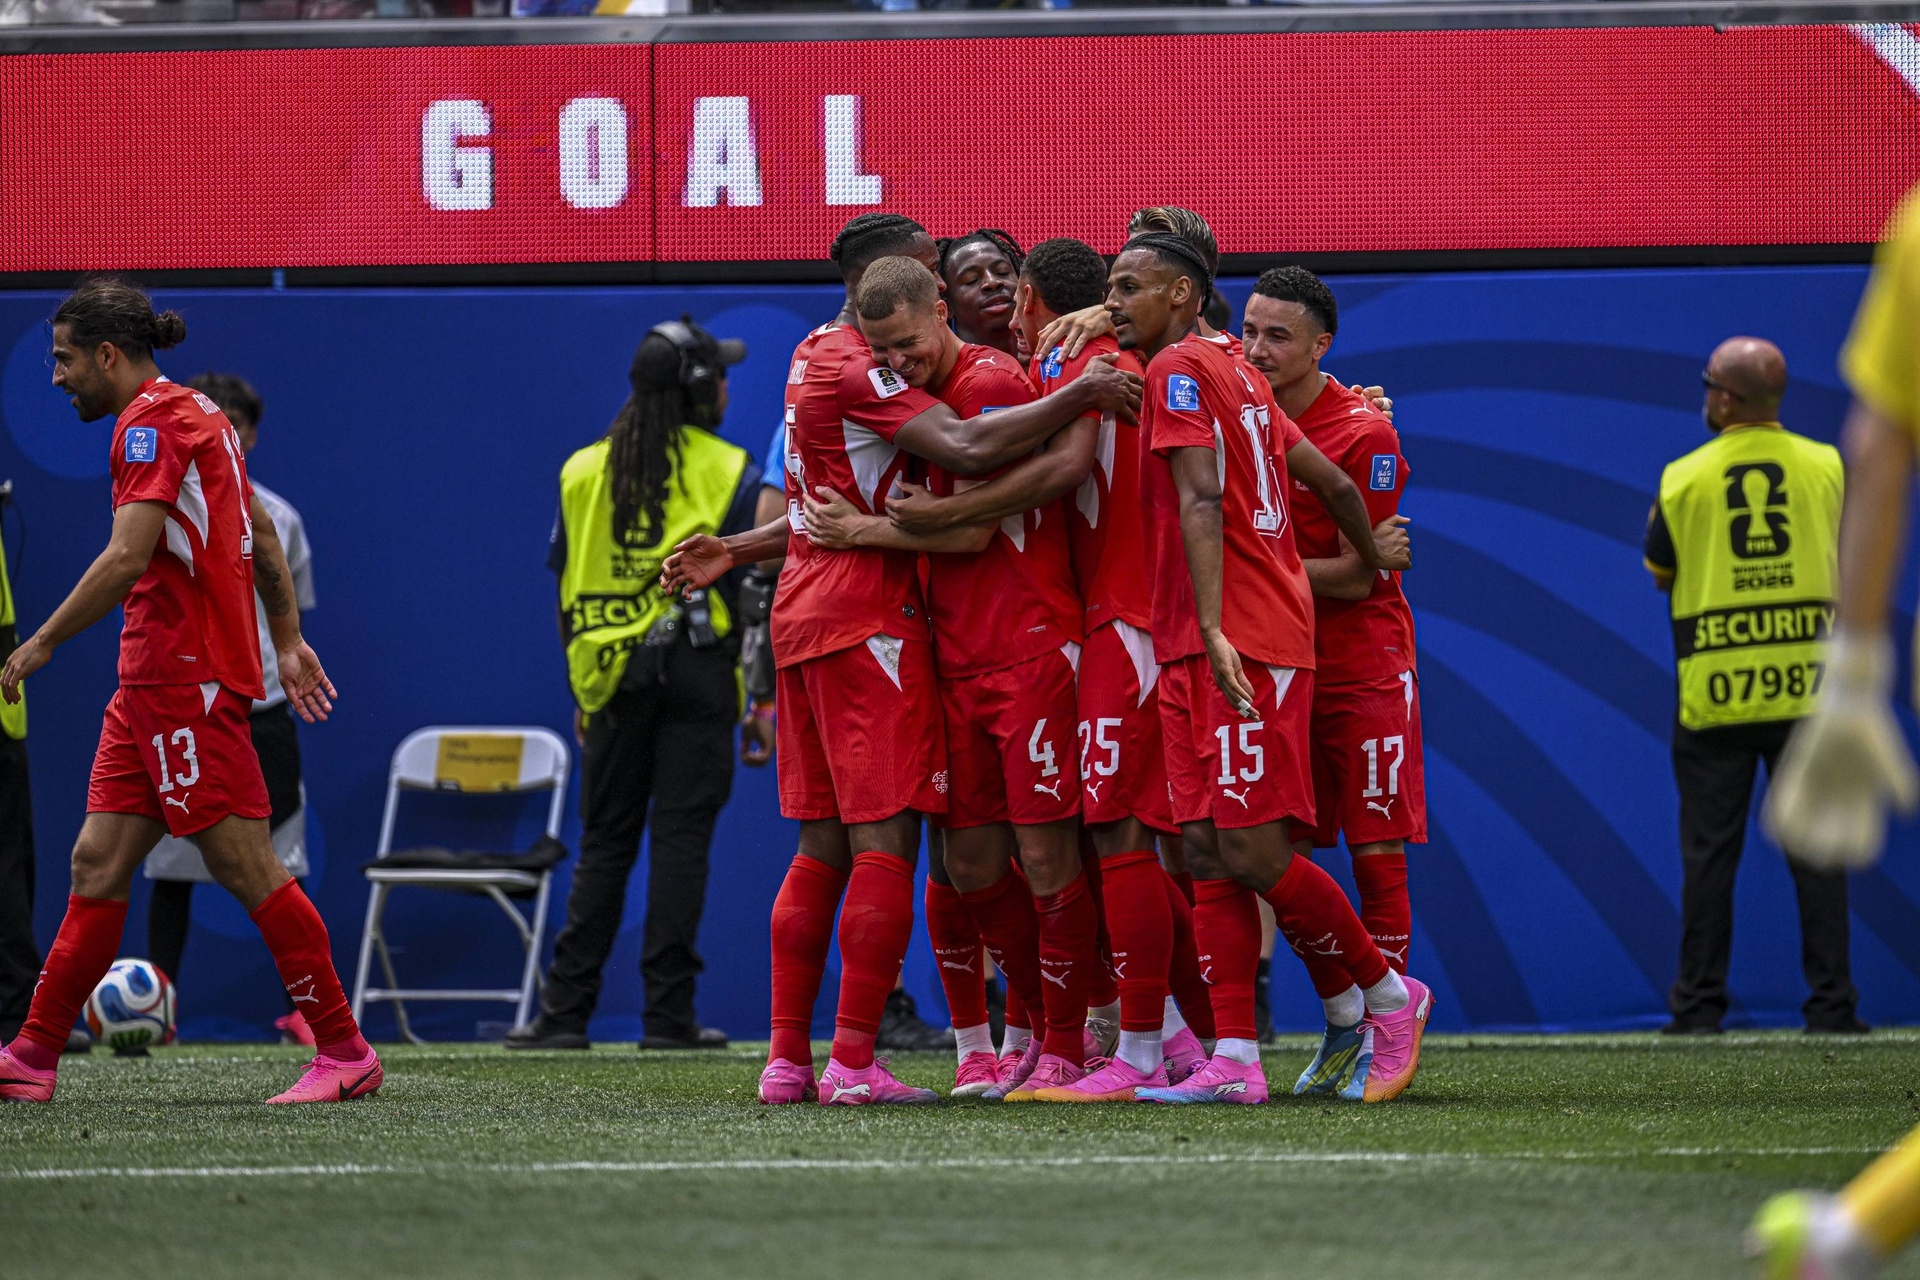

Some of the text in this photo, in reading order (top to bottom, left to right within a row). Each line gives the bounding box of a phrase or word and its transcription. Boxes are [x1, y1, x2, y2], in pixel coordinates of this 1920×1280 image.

[421, 95, 882, 211] GOAL
[1175, 395, 1191, 403] PEACE
[131, 447, 147, 455] PEACE
[1746, 536, 1777, 554] FIFA
[1734, 574, 1794, 593] 2026
[1693, 607, 1836, 650] SECURITY
[1708, 661, 1828, 706] 07987
[152, 727, 200, 793] 13
[1028, 718, 1059, 777] 4
[1077, 718, 1123, 781] 25
[1214, 720, 1265, 786] 15
[1360, 734, 1405, 798] 17
